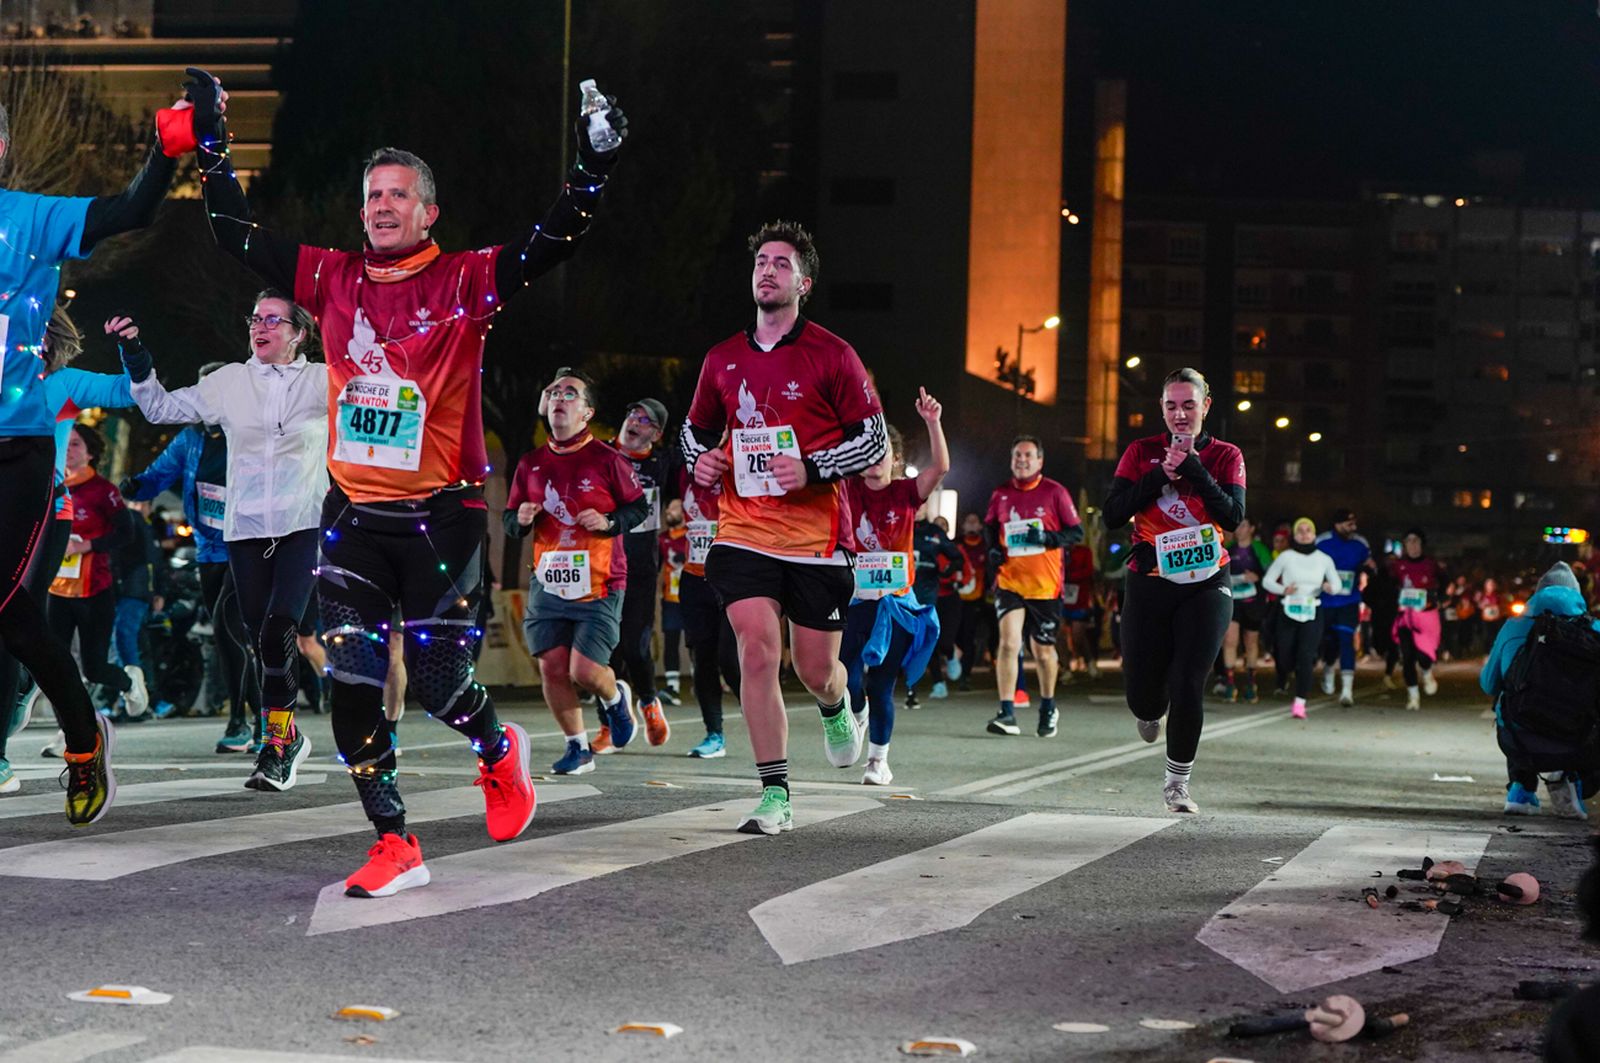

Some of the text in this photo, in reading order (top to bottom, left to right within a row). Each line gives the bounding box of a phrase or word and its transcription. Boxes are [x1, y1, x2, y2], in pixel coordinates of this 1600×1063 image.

[360, 350, 384, 374] 43
[354, 385, 390, 396] NOCHE DE
[345, 393, 359, 404] SAN
[350, 407, 402, 438] 4877
[762, 434, 770, 443] DE
[1167, 503, 1187, 519] 43
[1169, 531, 1197, 543] NOCHE DE
[1163, 543, 1176, 551] SAN
[1165, 543, 1215, 568] 13239
[544, 568, 581, 584] 6036
[868, 569, 892, 584] 144
